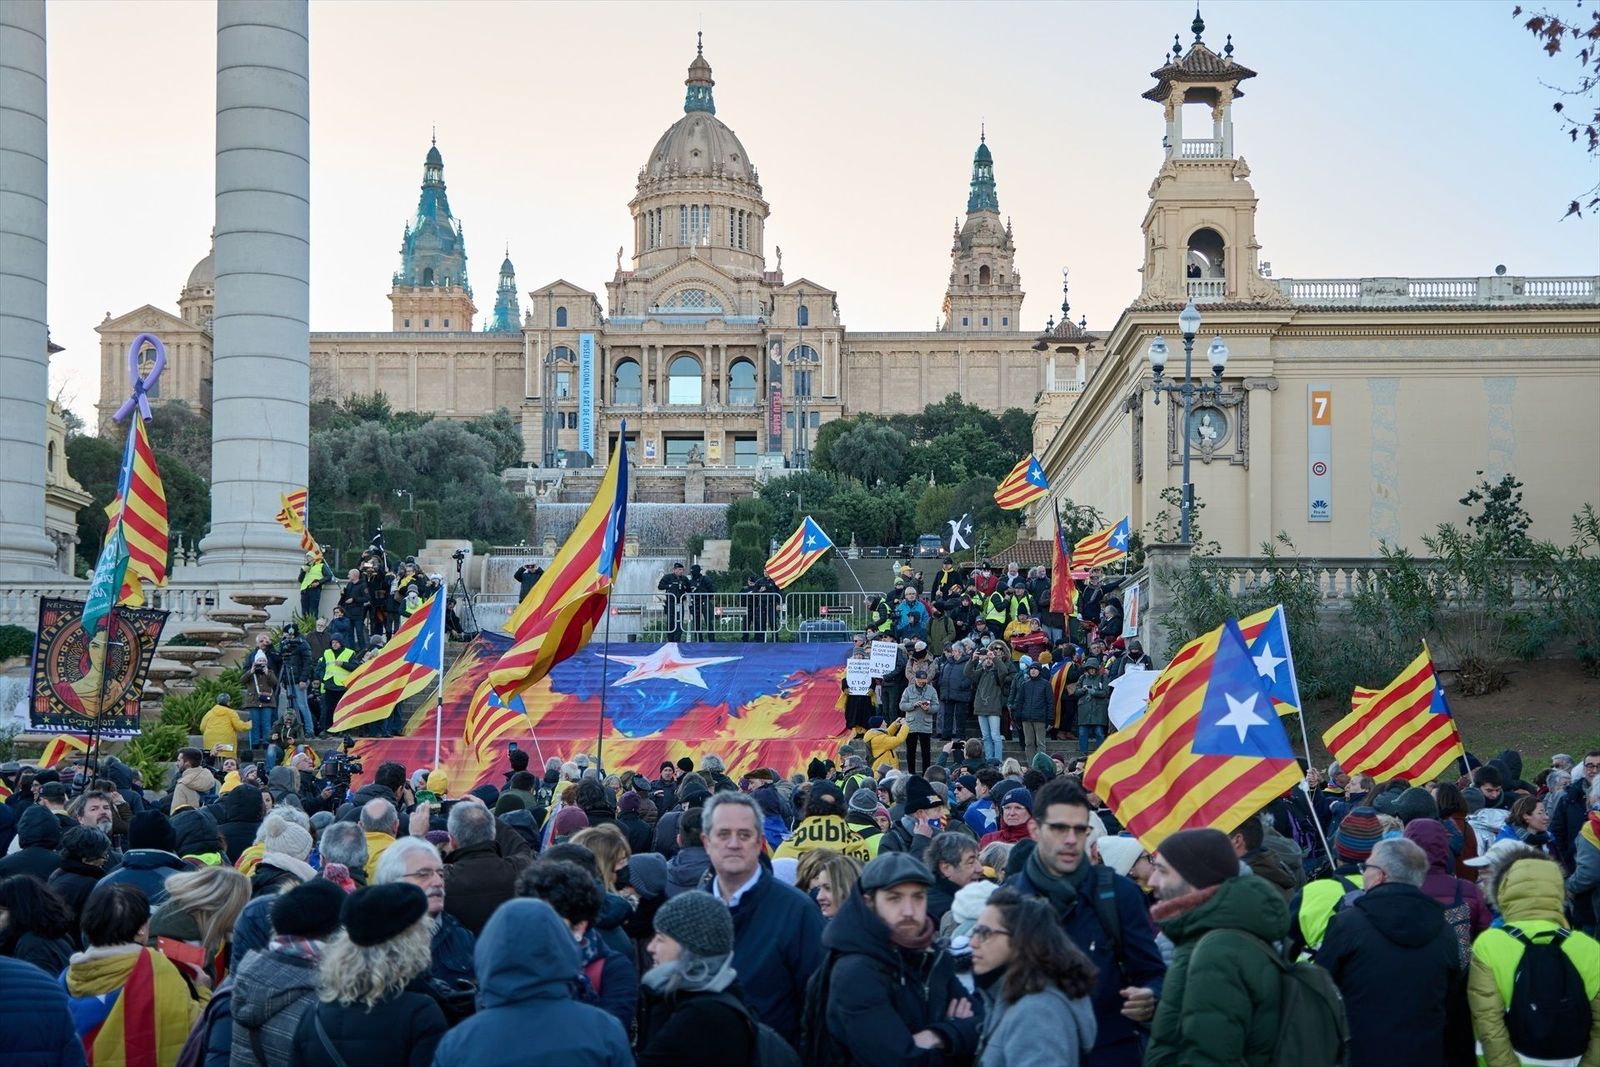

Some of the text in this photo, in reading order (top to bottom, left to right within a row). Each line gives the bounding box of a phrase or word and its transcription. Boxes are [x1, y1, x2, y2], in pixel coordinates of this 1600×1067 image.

[582, 340, 590, 358] MUSEU
[582, 361, 590, 388] NACIONAL
[582, 392, 590, 406] D'ART
[1314, 398, 1328, 418] 7
[582, 420, 590, 450] CATALUNYA
